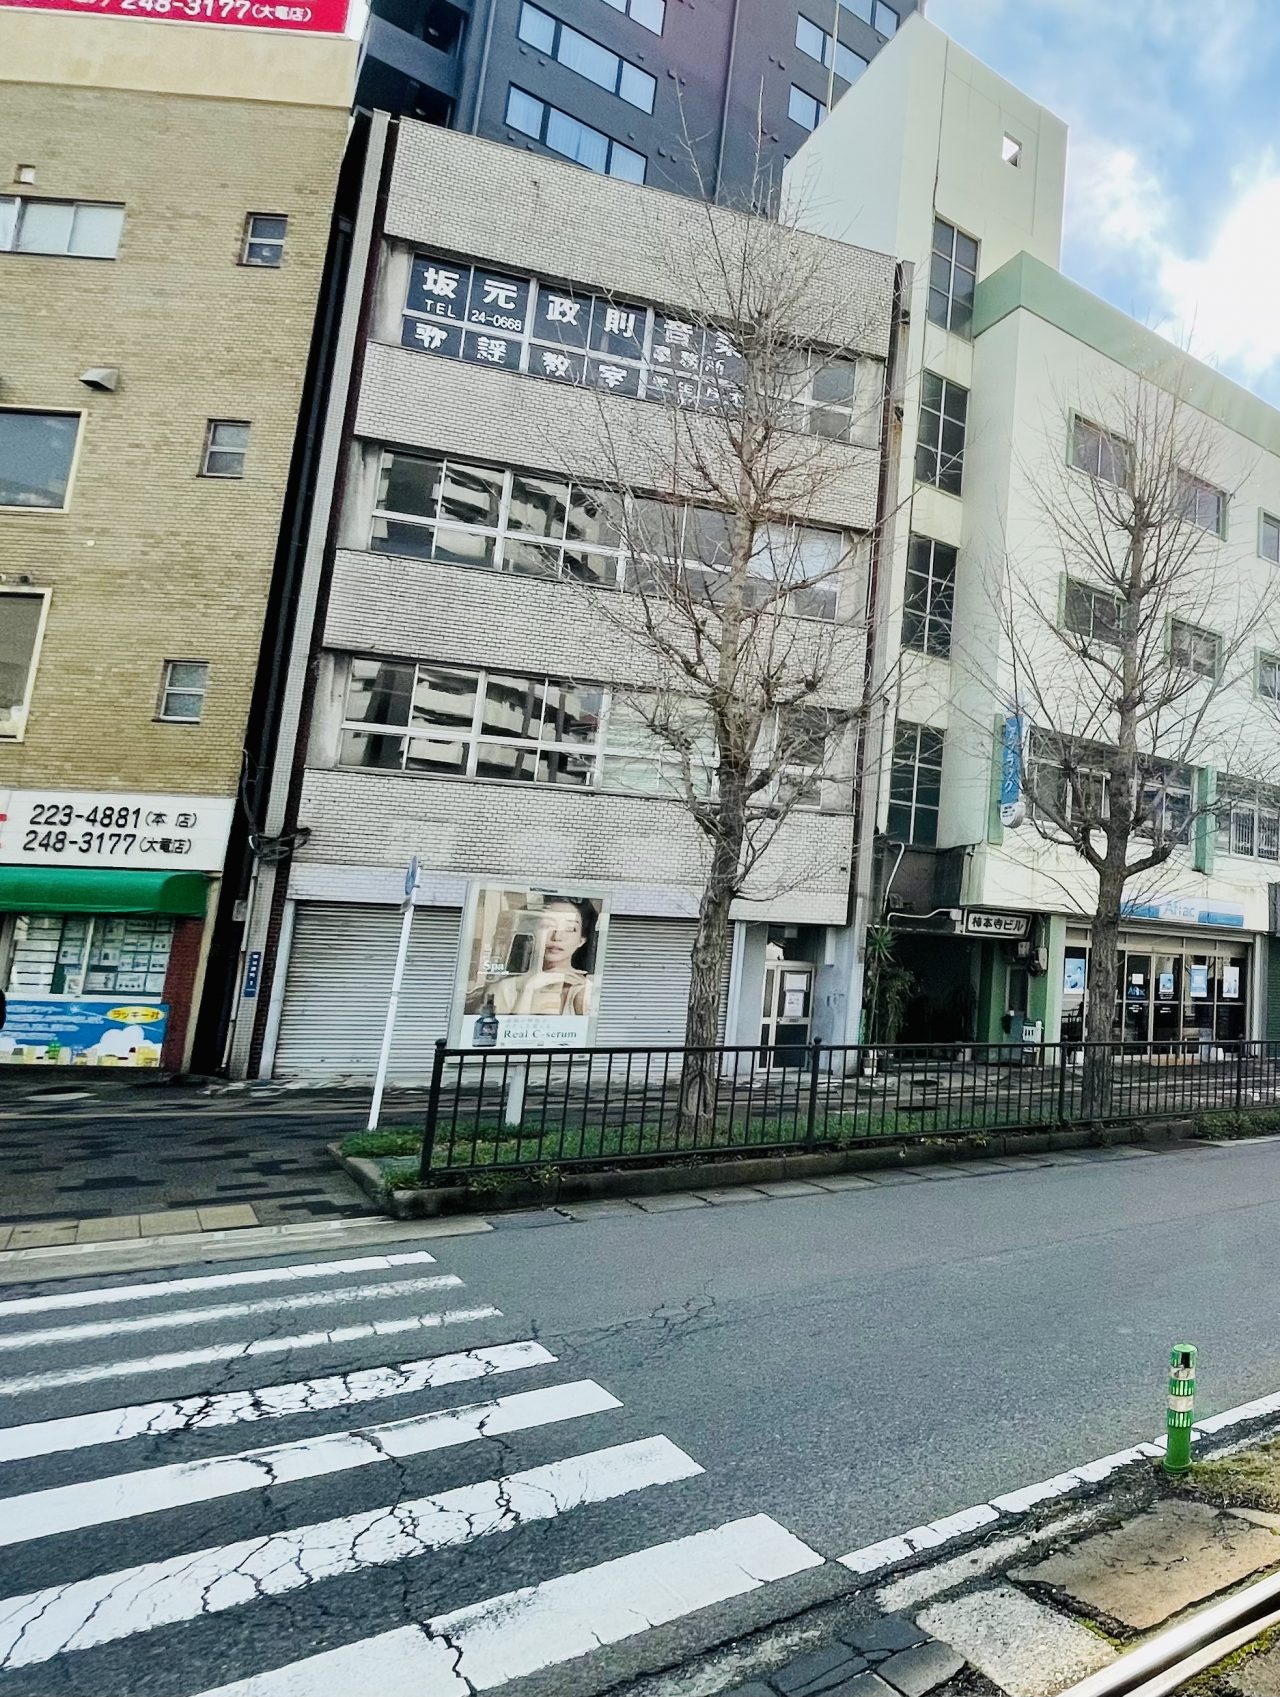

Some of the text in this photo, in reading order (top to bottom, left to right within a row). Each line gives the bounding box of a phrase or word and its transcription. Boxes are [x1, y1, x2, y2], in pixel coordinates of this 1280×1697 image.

[425, 299, 523, 333] TEL 24-0668
[1164, 900, 1195, 918] Aflac
[504, 1029, 528, 1039] Real
